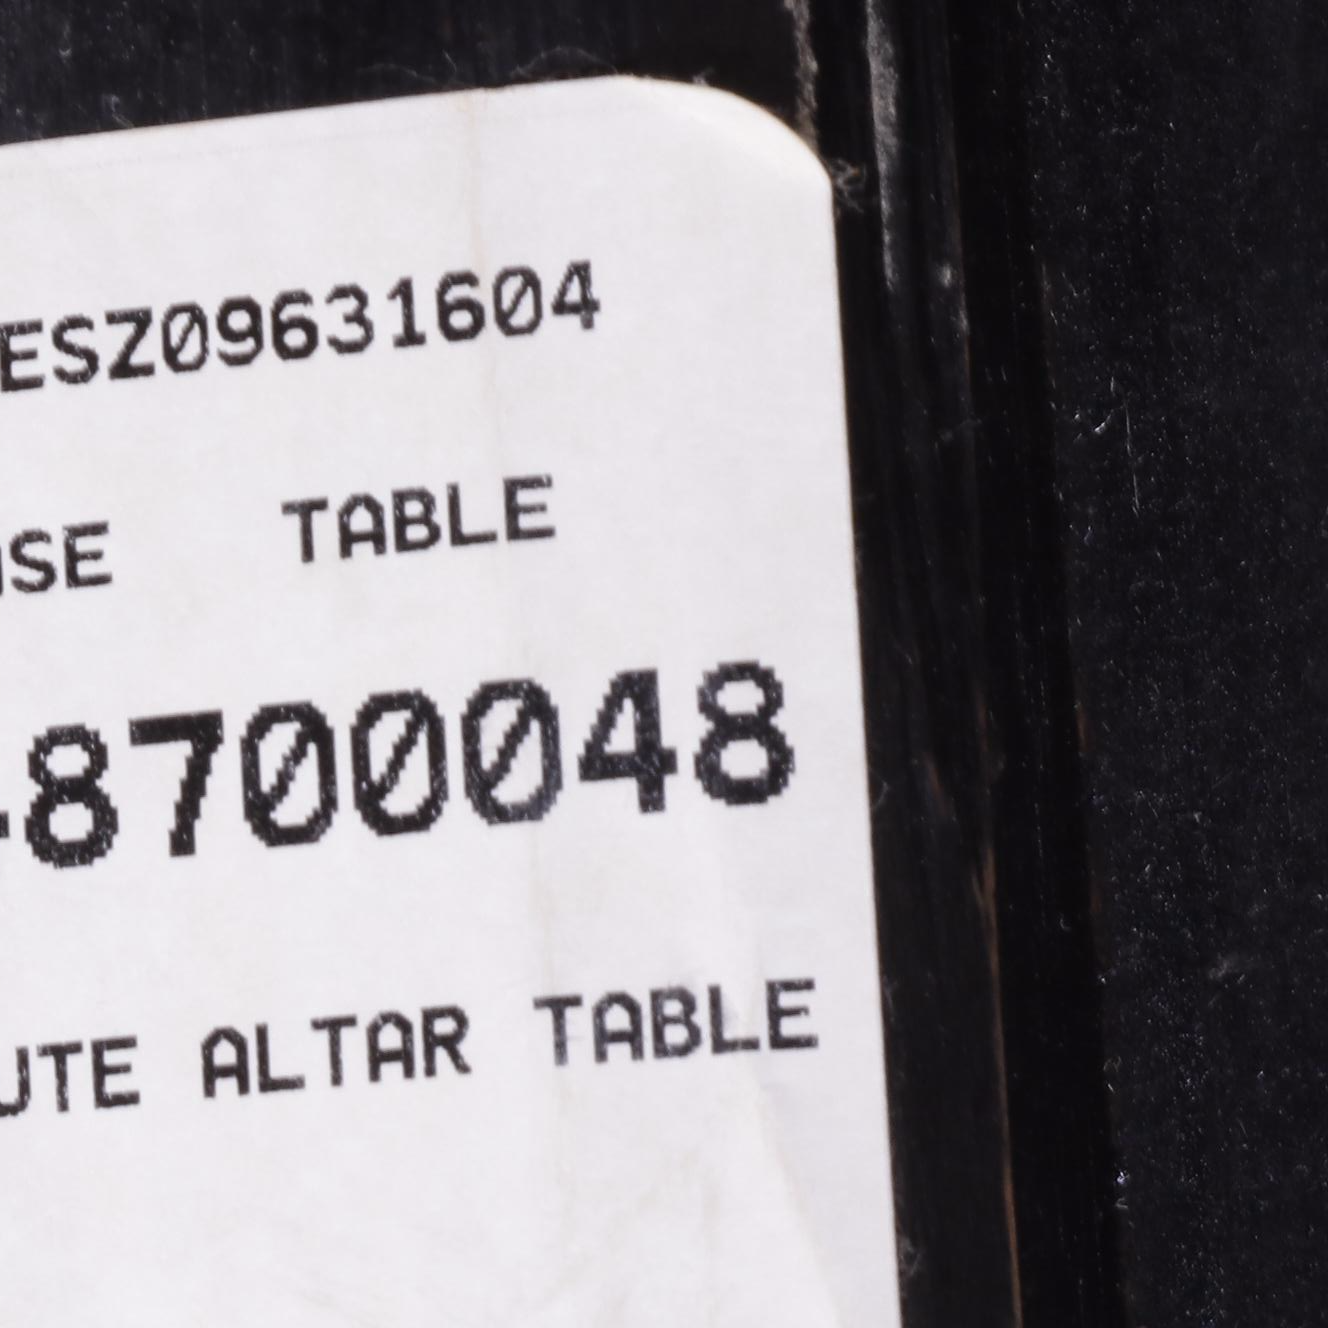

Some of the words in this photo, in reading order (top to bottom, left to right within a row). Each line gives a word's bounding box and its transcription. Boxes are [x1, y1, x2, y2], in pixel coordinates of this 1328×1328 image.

[281, 476, 556, 564] TABLE
[201, 1005, 471, 1094] ALTAR
[533, 978, 819, 1065] TABLE
